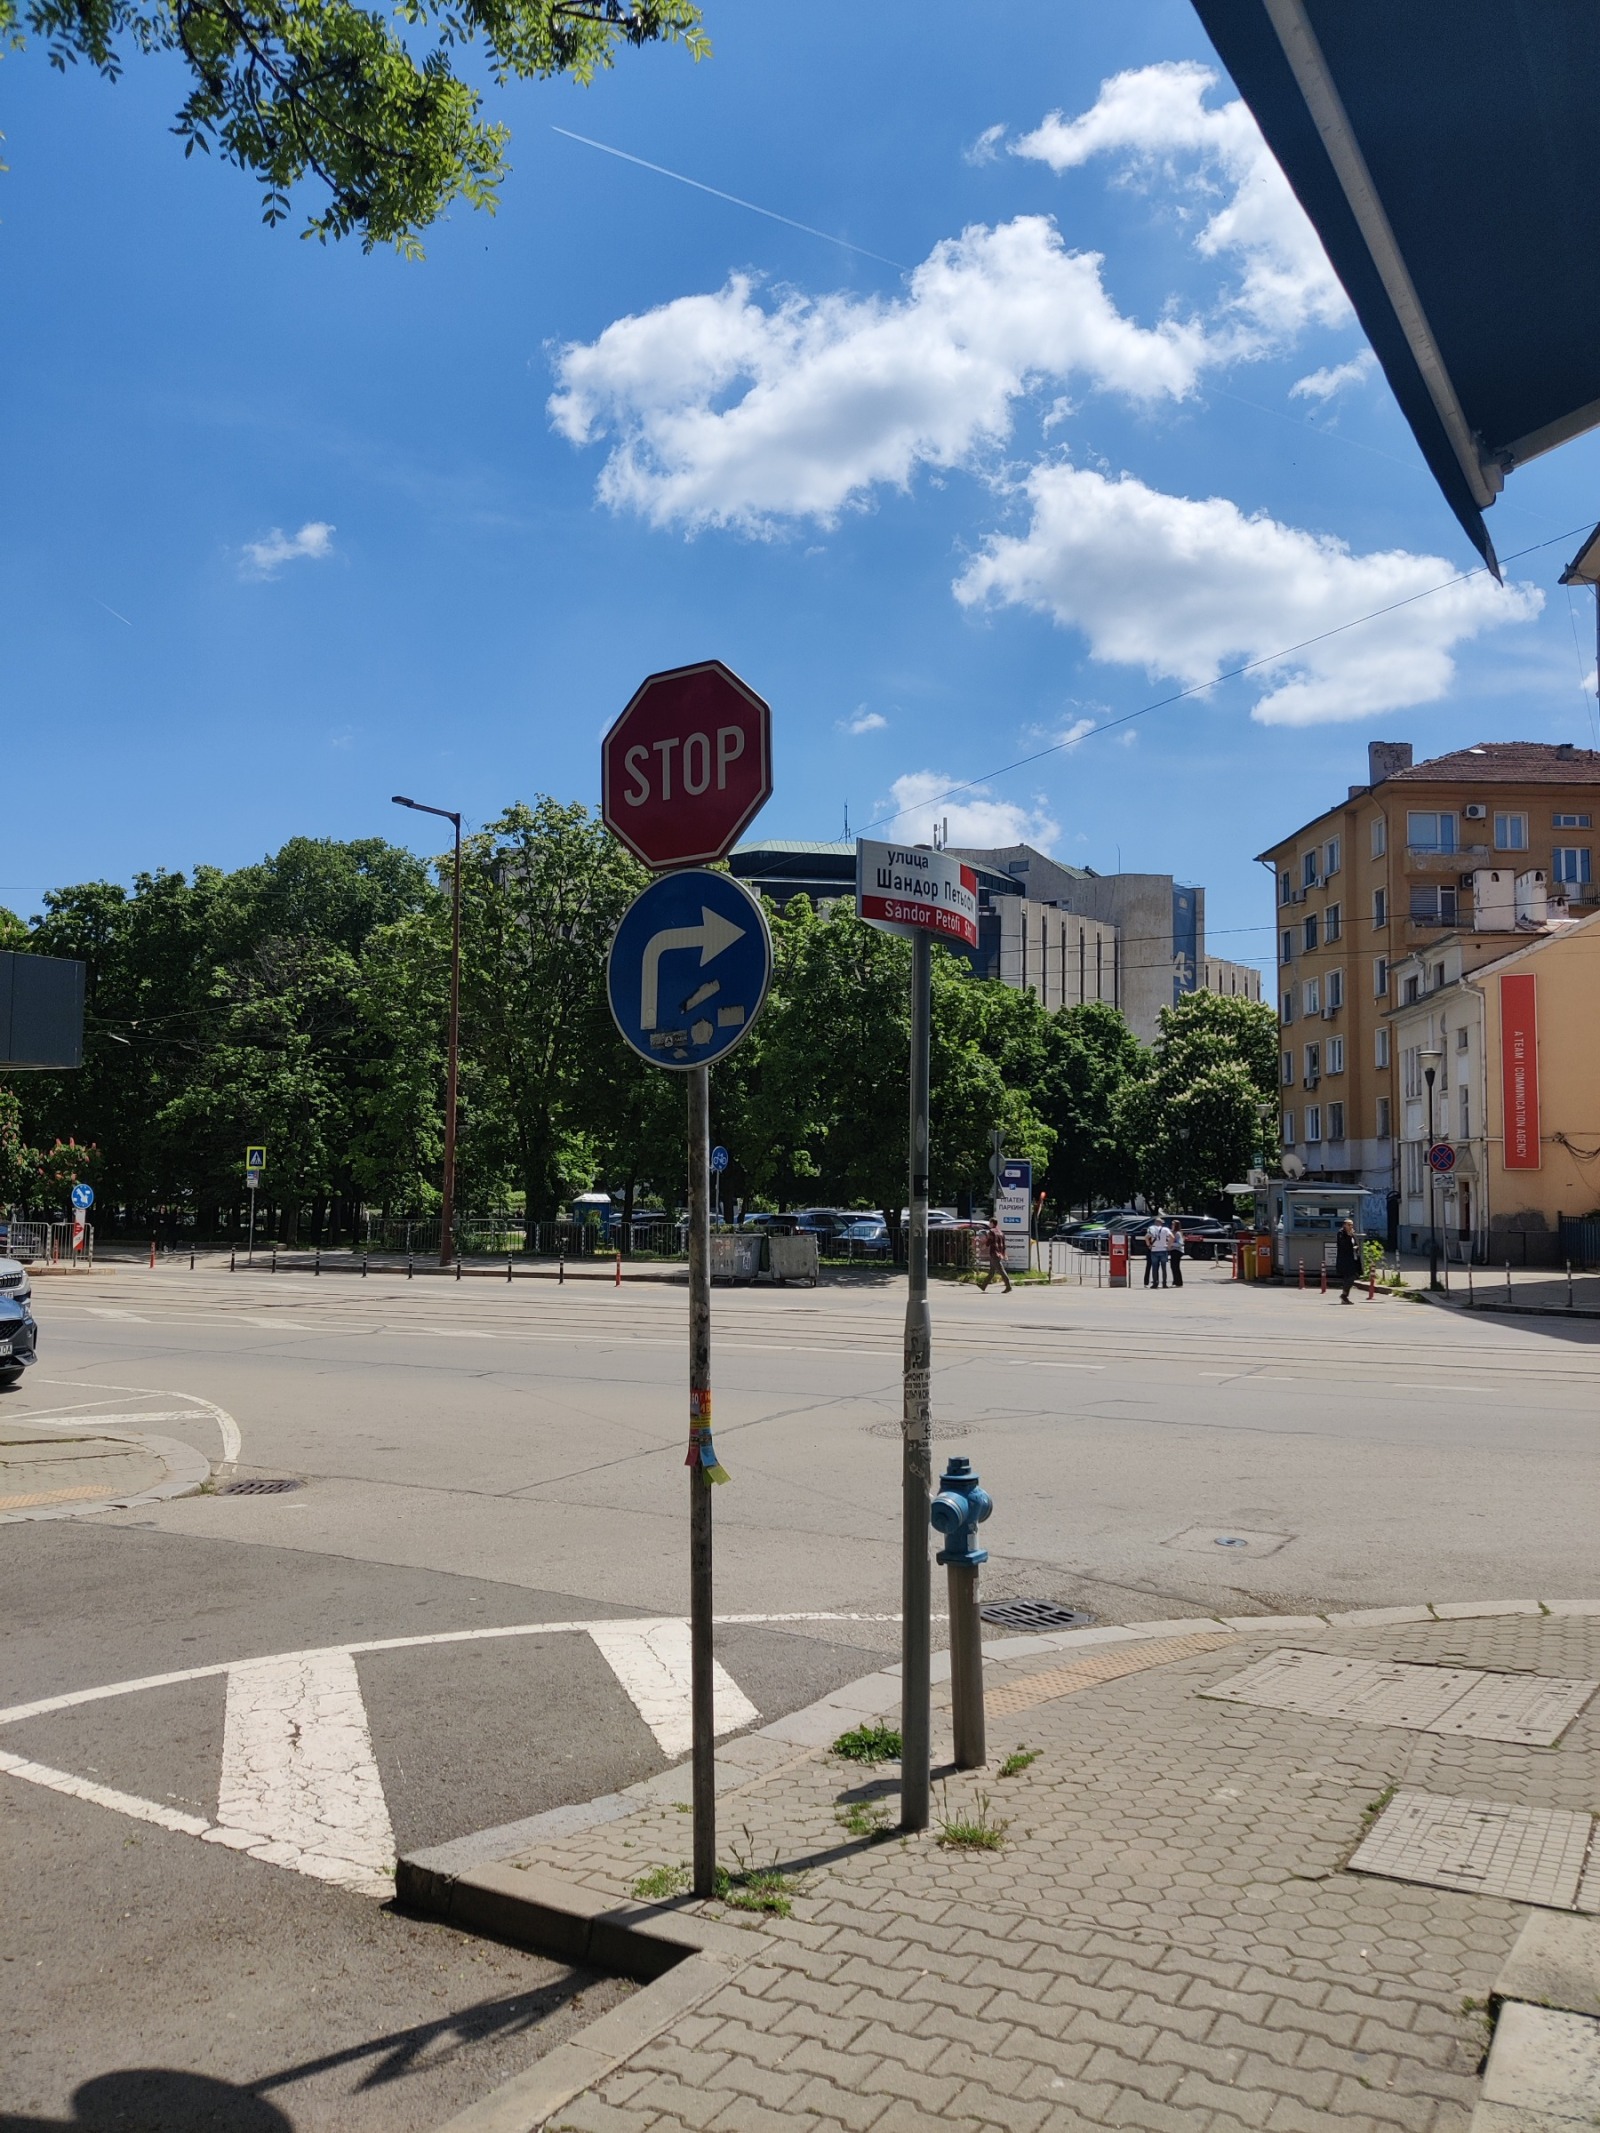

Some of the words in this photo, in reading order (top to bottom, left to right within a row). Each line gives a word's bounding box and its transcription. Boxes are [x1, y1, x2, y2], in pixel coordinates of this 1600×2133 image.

[623, 725, 746, 808] STOP
[887, 850, 929, 869] улица
[876, 867, 938, 902] Шандор
[884, 899, 931, 923] Sándor
[1514, 1038, 1524, 1058] TEAM
[1515, 1128, 1527, 1158] AGENCY
